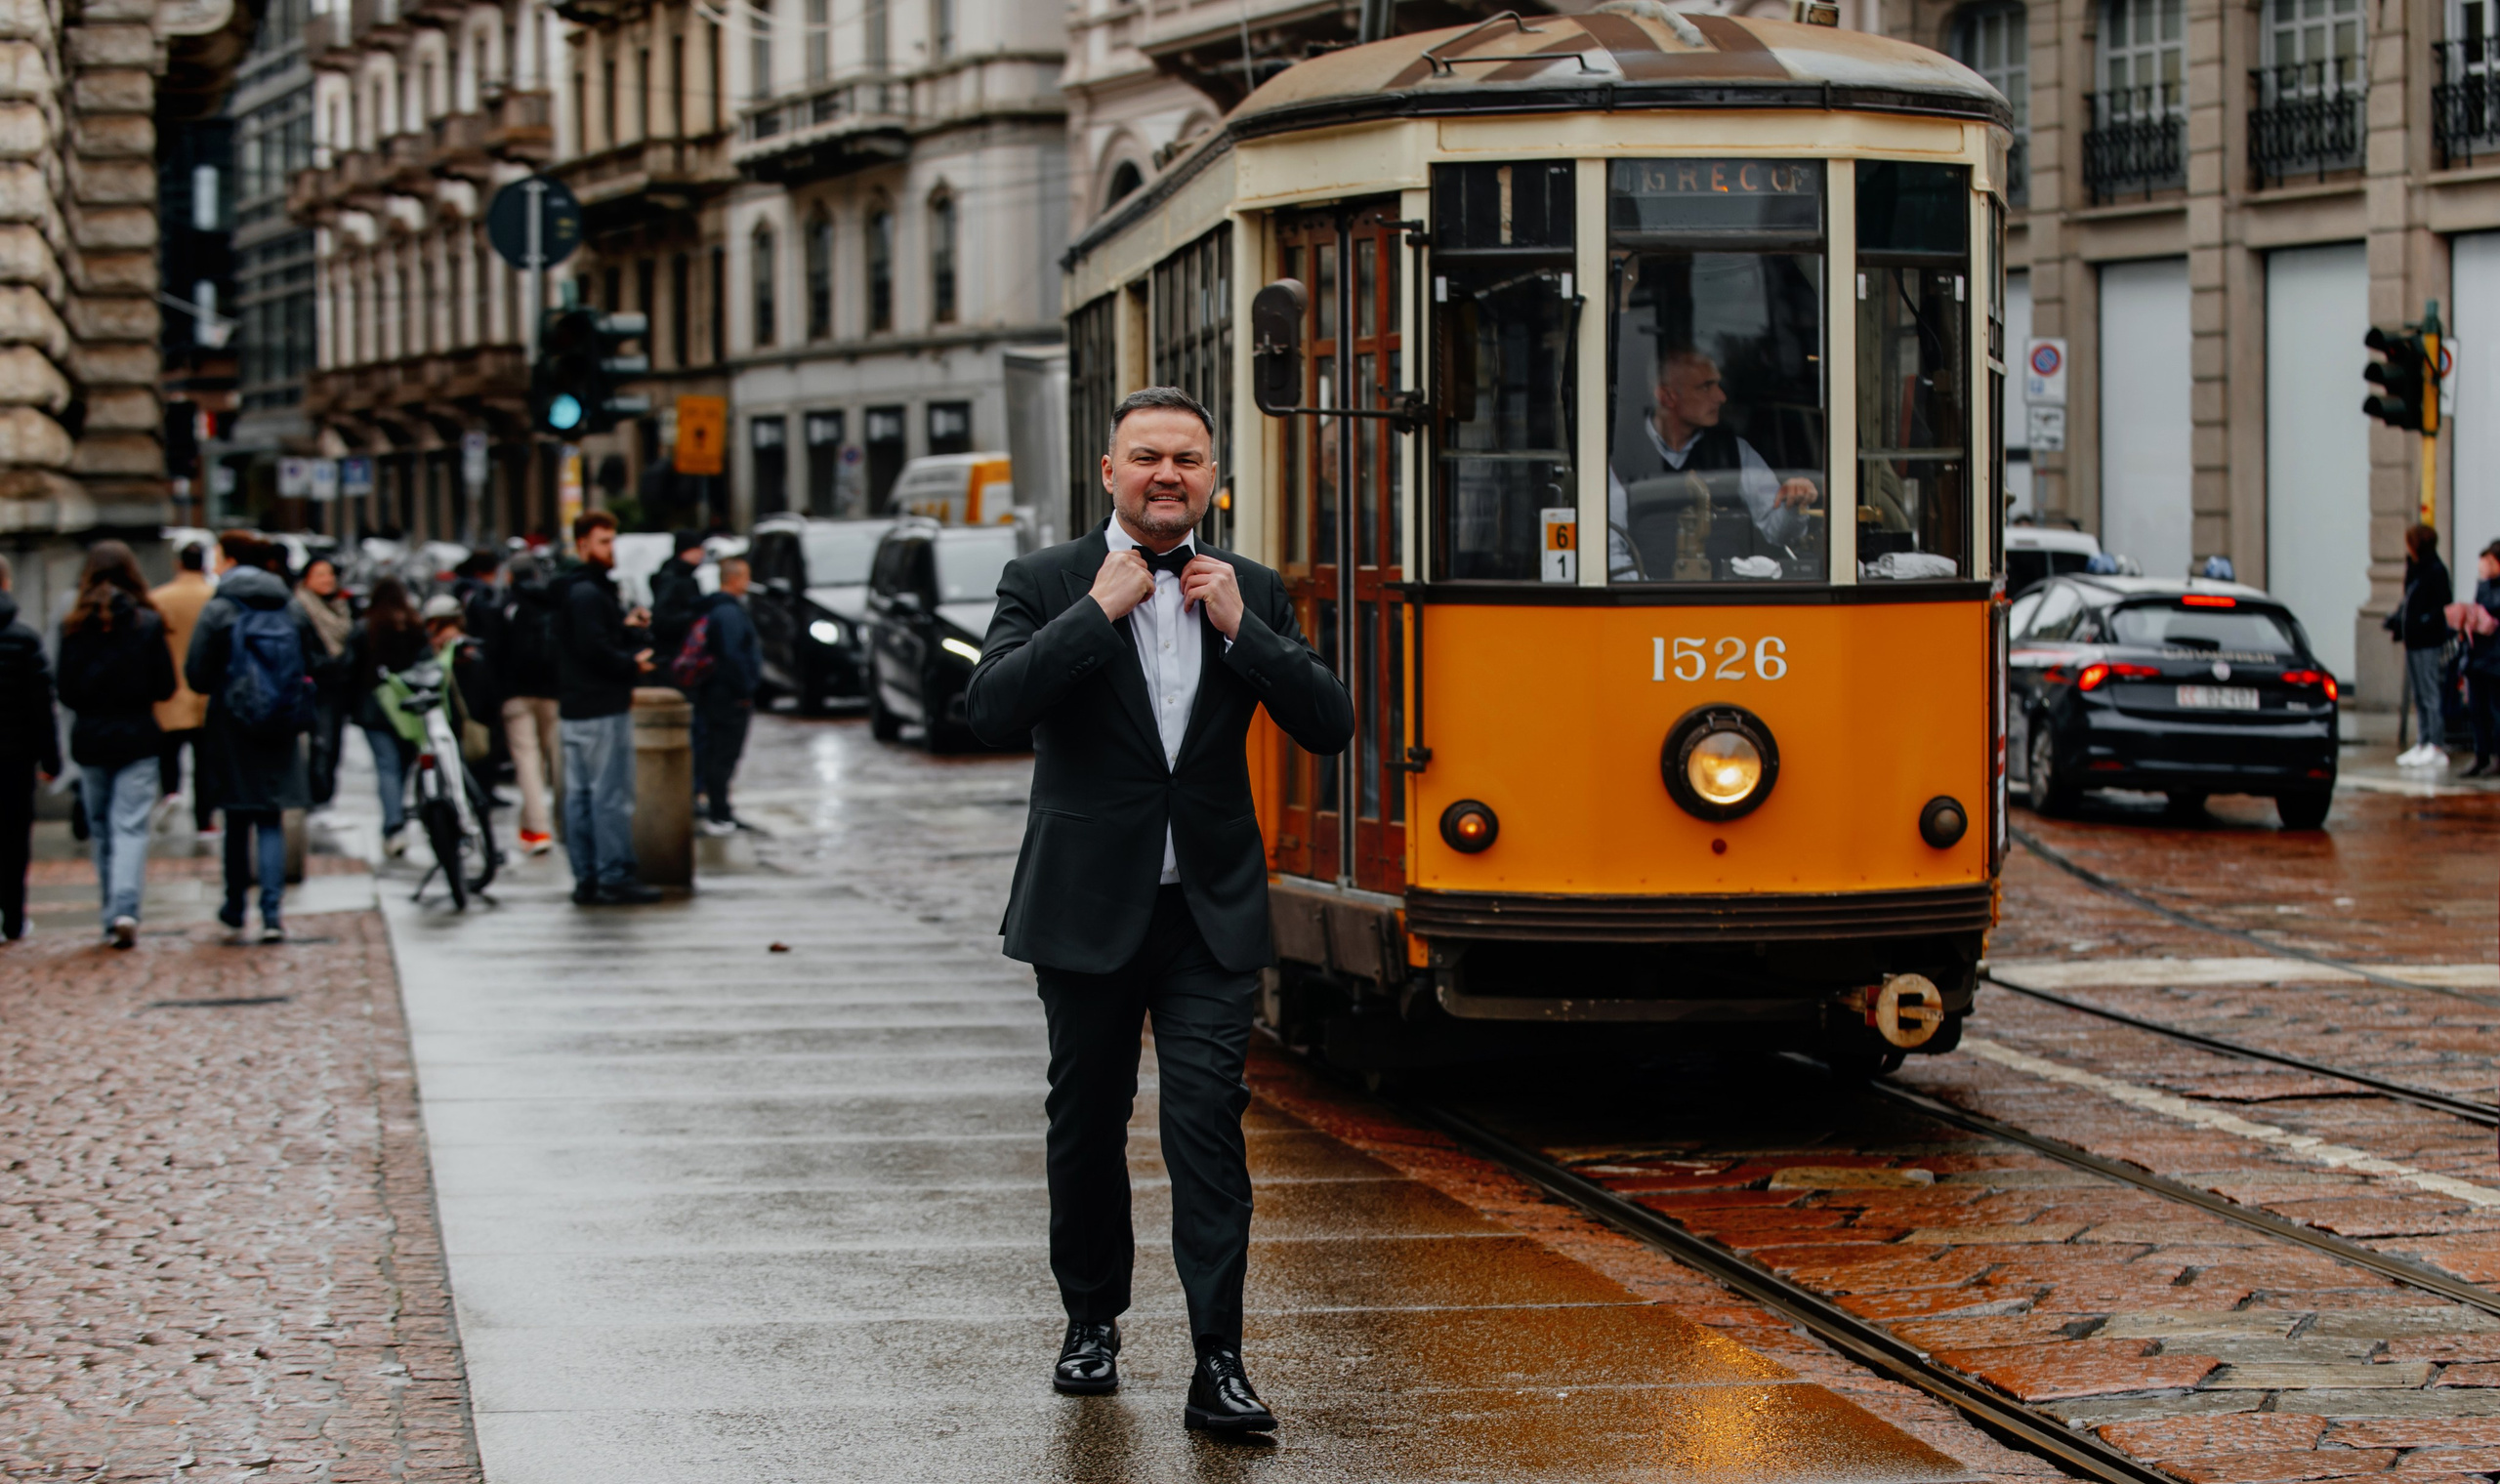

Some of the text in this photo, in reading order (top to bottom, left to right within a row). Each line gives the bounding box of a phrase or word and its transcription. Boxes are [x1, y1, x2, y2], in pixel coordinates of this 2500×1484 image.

[1556, 524, 1569, 549] 6
[1557, 554, 1566, 578] 1
[1651, 636, 1788, 681] 1526
